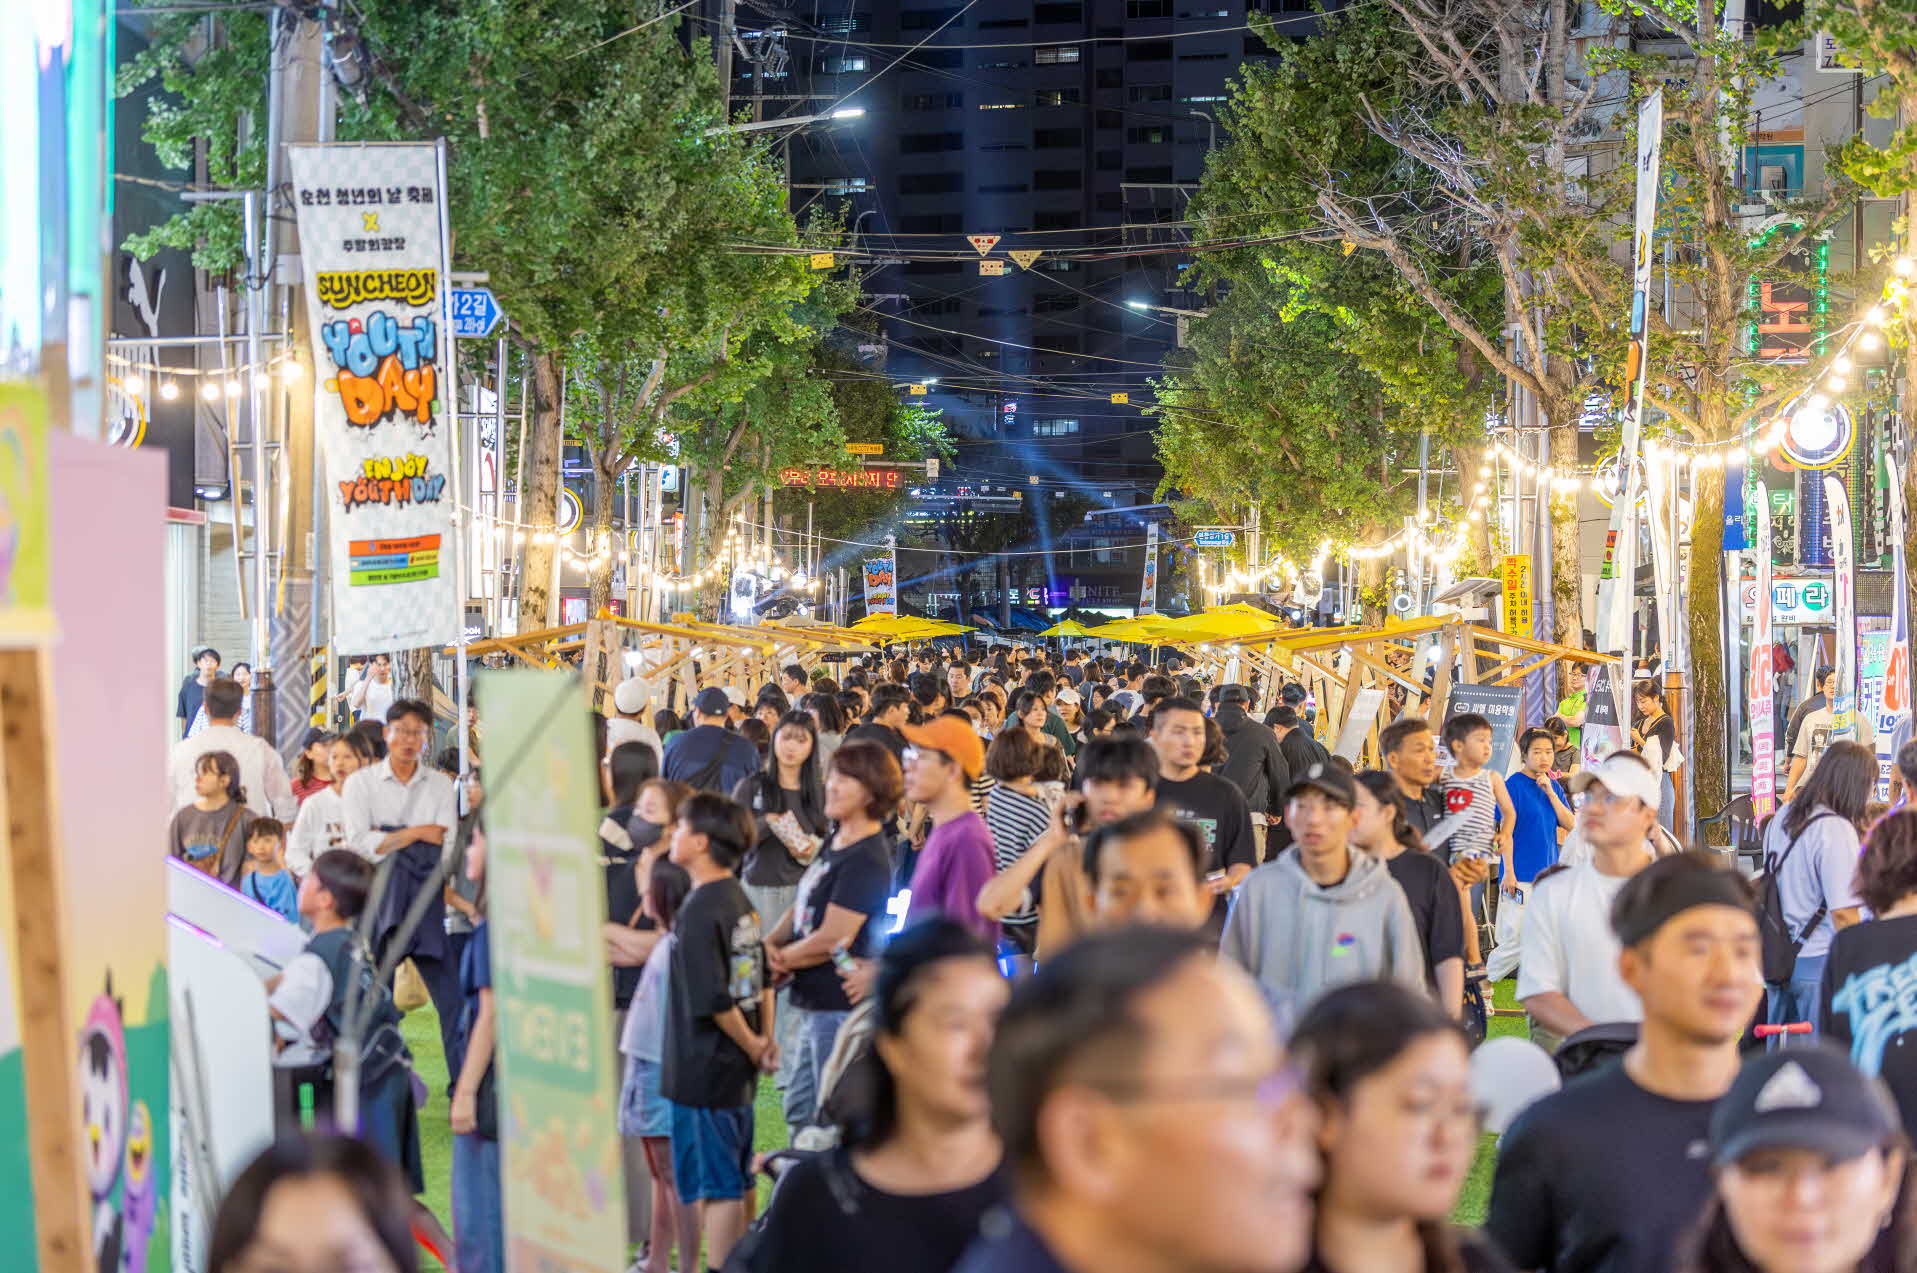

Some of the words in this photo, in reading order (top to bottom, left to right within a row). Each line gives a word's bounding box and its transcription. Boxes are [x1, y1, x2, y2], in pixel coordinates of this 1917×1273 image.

[301, 188, 331, 206] 순천
[336, 187, 382, 204] 청년의
[386, 186, 403, 203] 날
[407, 185, 434, 204] 축제
[317, 269, 437, 309] SUNCHEON
[322, 311, 437, 378] YOUTH
[336, 354, 438, 428] DAY
[363, 452, 429, 482] ENJOY
[338, 477, 411, 508] YOUTH
[411, 474, 446, 503] DAY
[1506, 557, 1518, 591] 짝수일
